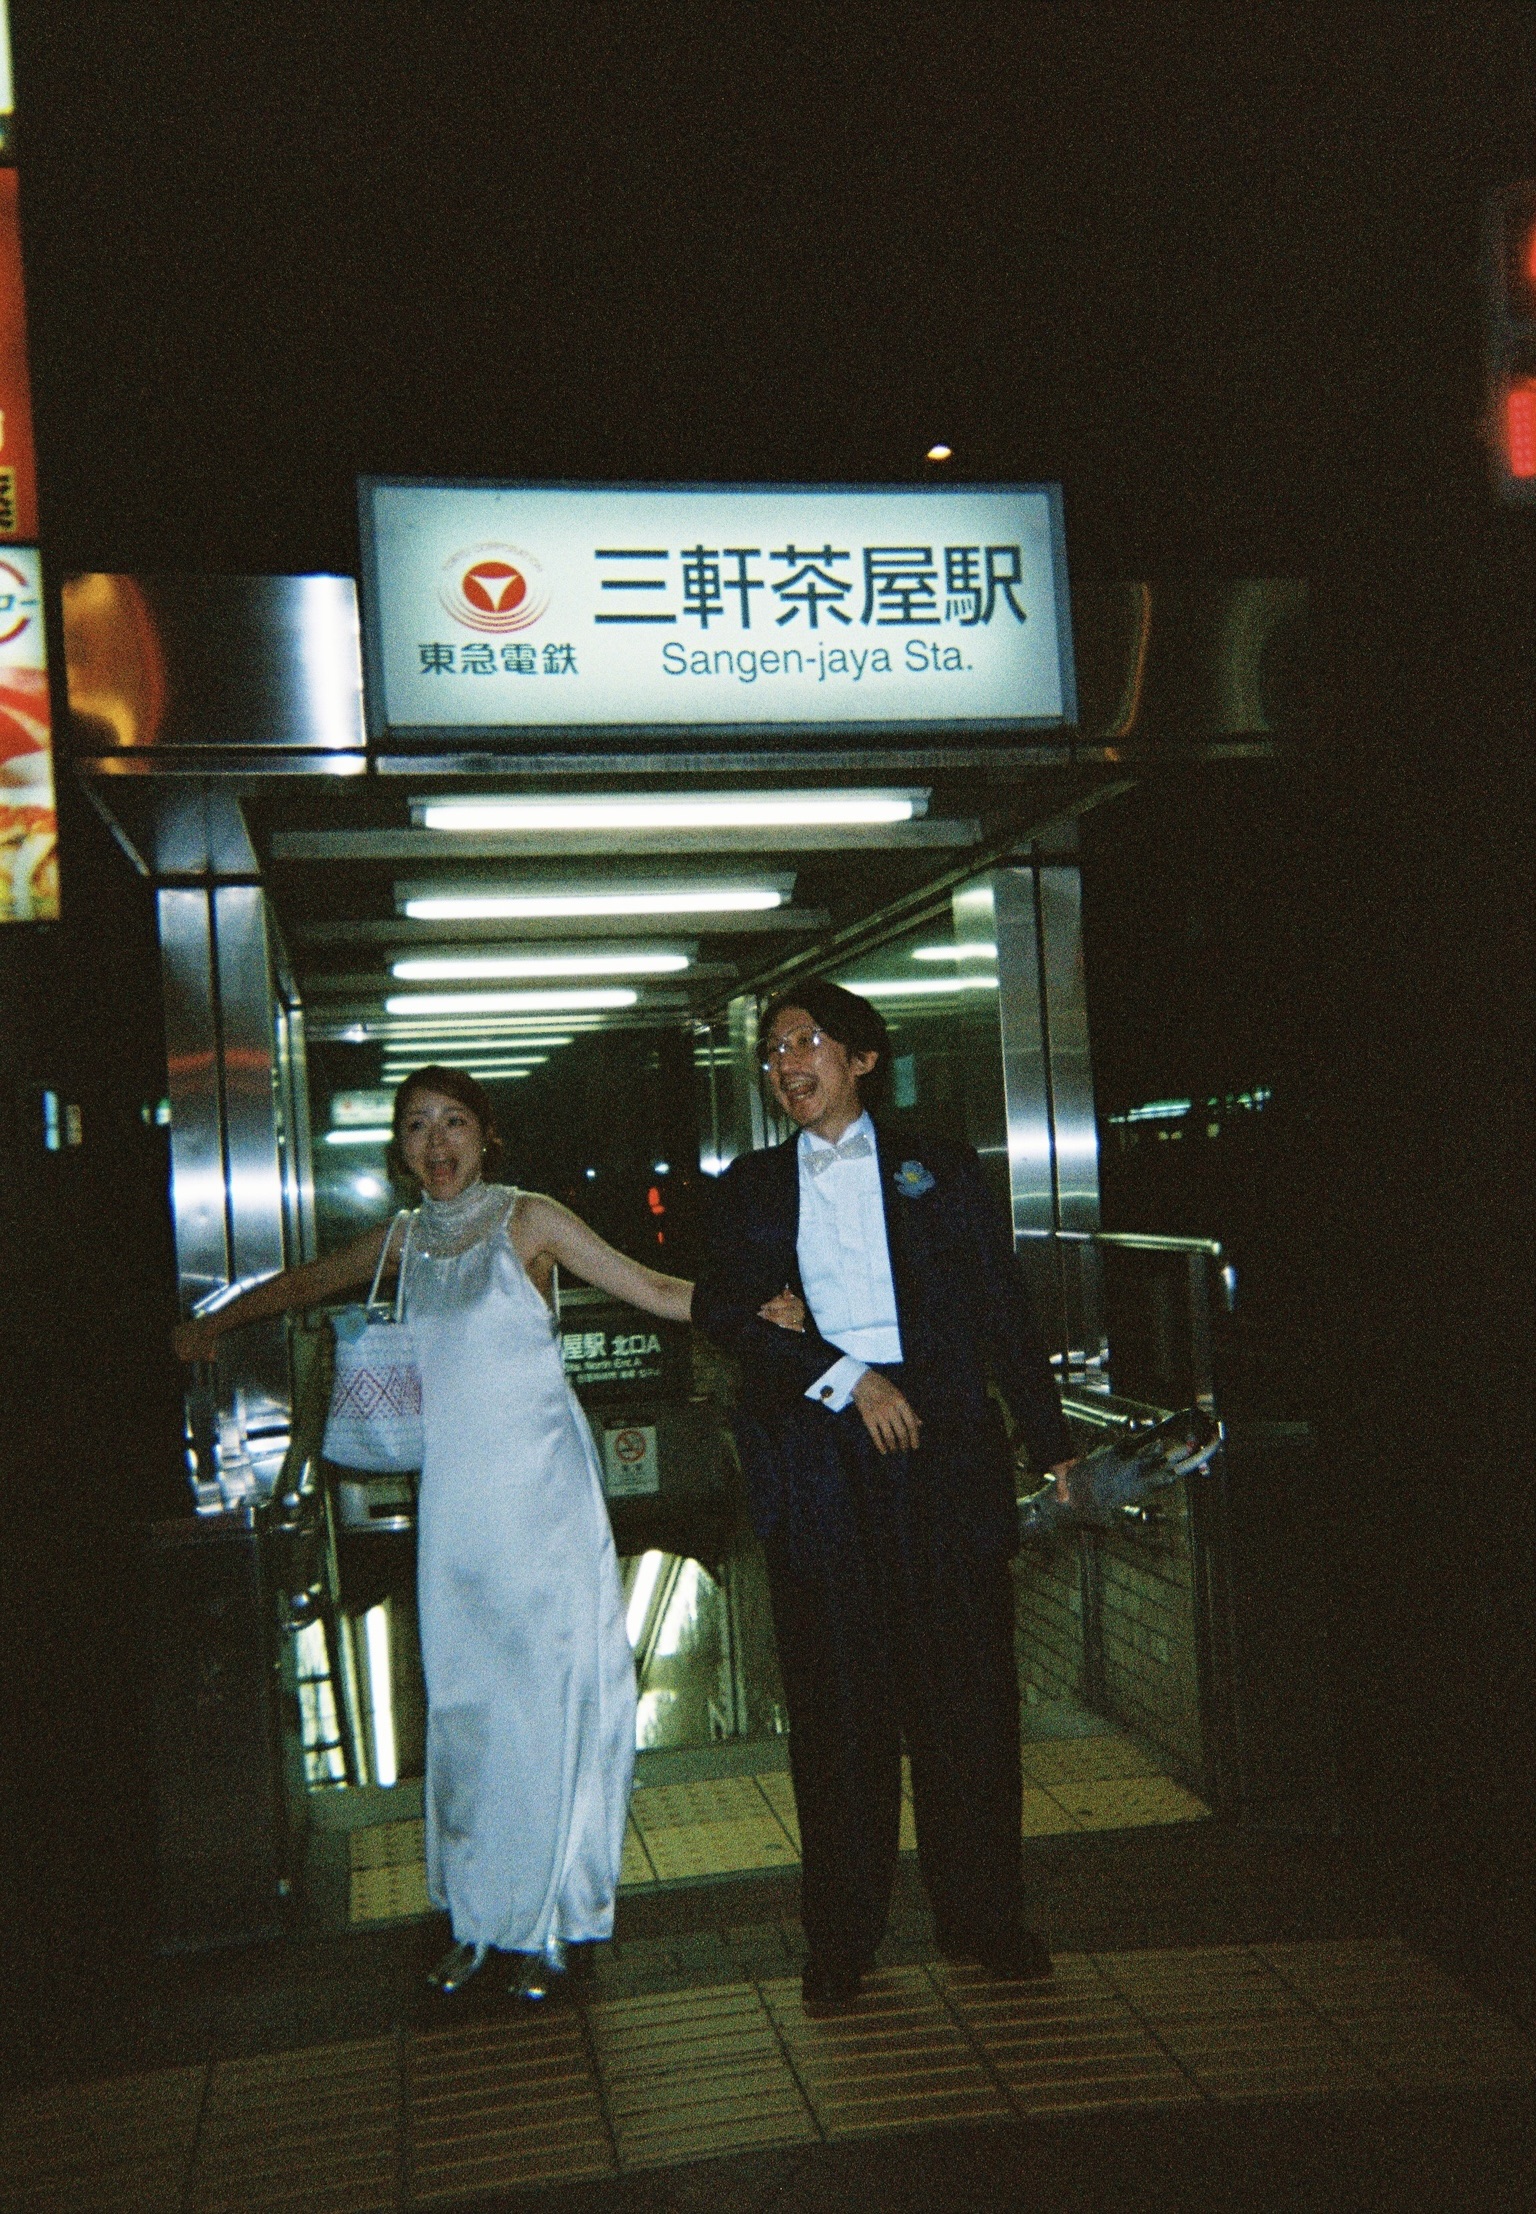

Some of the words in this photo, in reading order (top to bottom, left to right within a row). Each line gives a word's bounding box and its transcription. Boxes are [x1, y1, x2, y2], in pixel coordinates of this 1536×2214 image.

[594, 543, 1028, 629] 三軒茶屋駅
[419, 643, 579, 676] 東急電鉄
[662, 641, 893, 684] Sangen-jaya
[904, 639, 974, 674] Sta.
